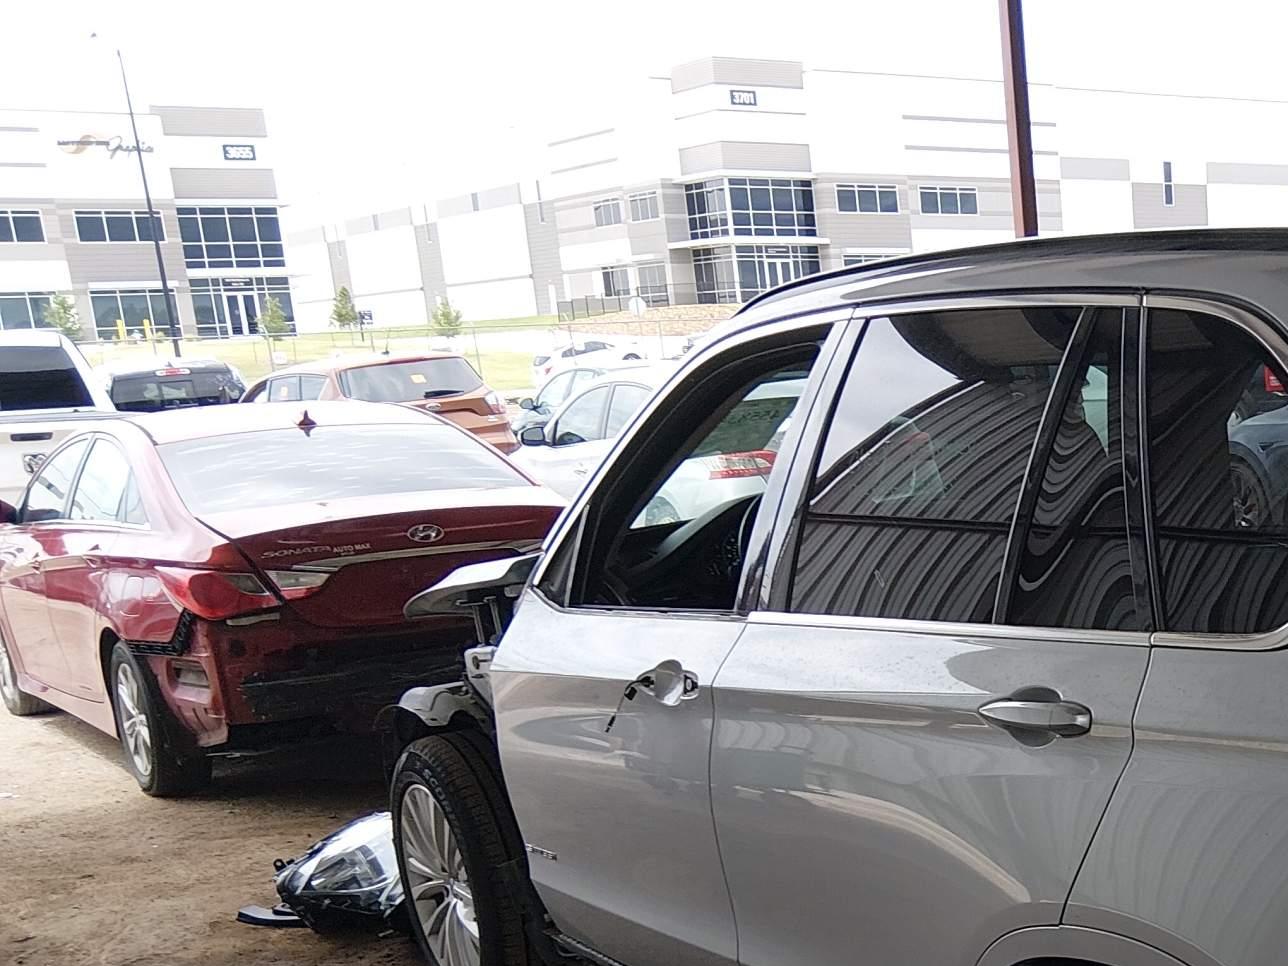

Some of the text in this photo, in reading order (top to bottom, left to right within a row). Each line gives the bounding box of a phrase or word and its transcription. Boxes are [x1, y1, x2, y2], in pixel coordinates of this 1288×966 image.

[733, 91, 755, 104] 3701
[261, 546, 332, 559] SONATA
[332, 542, 372, 553] AUTO MAX
